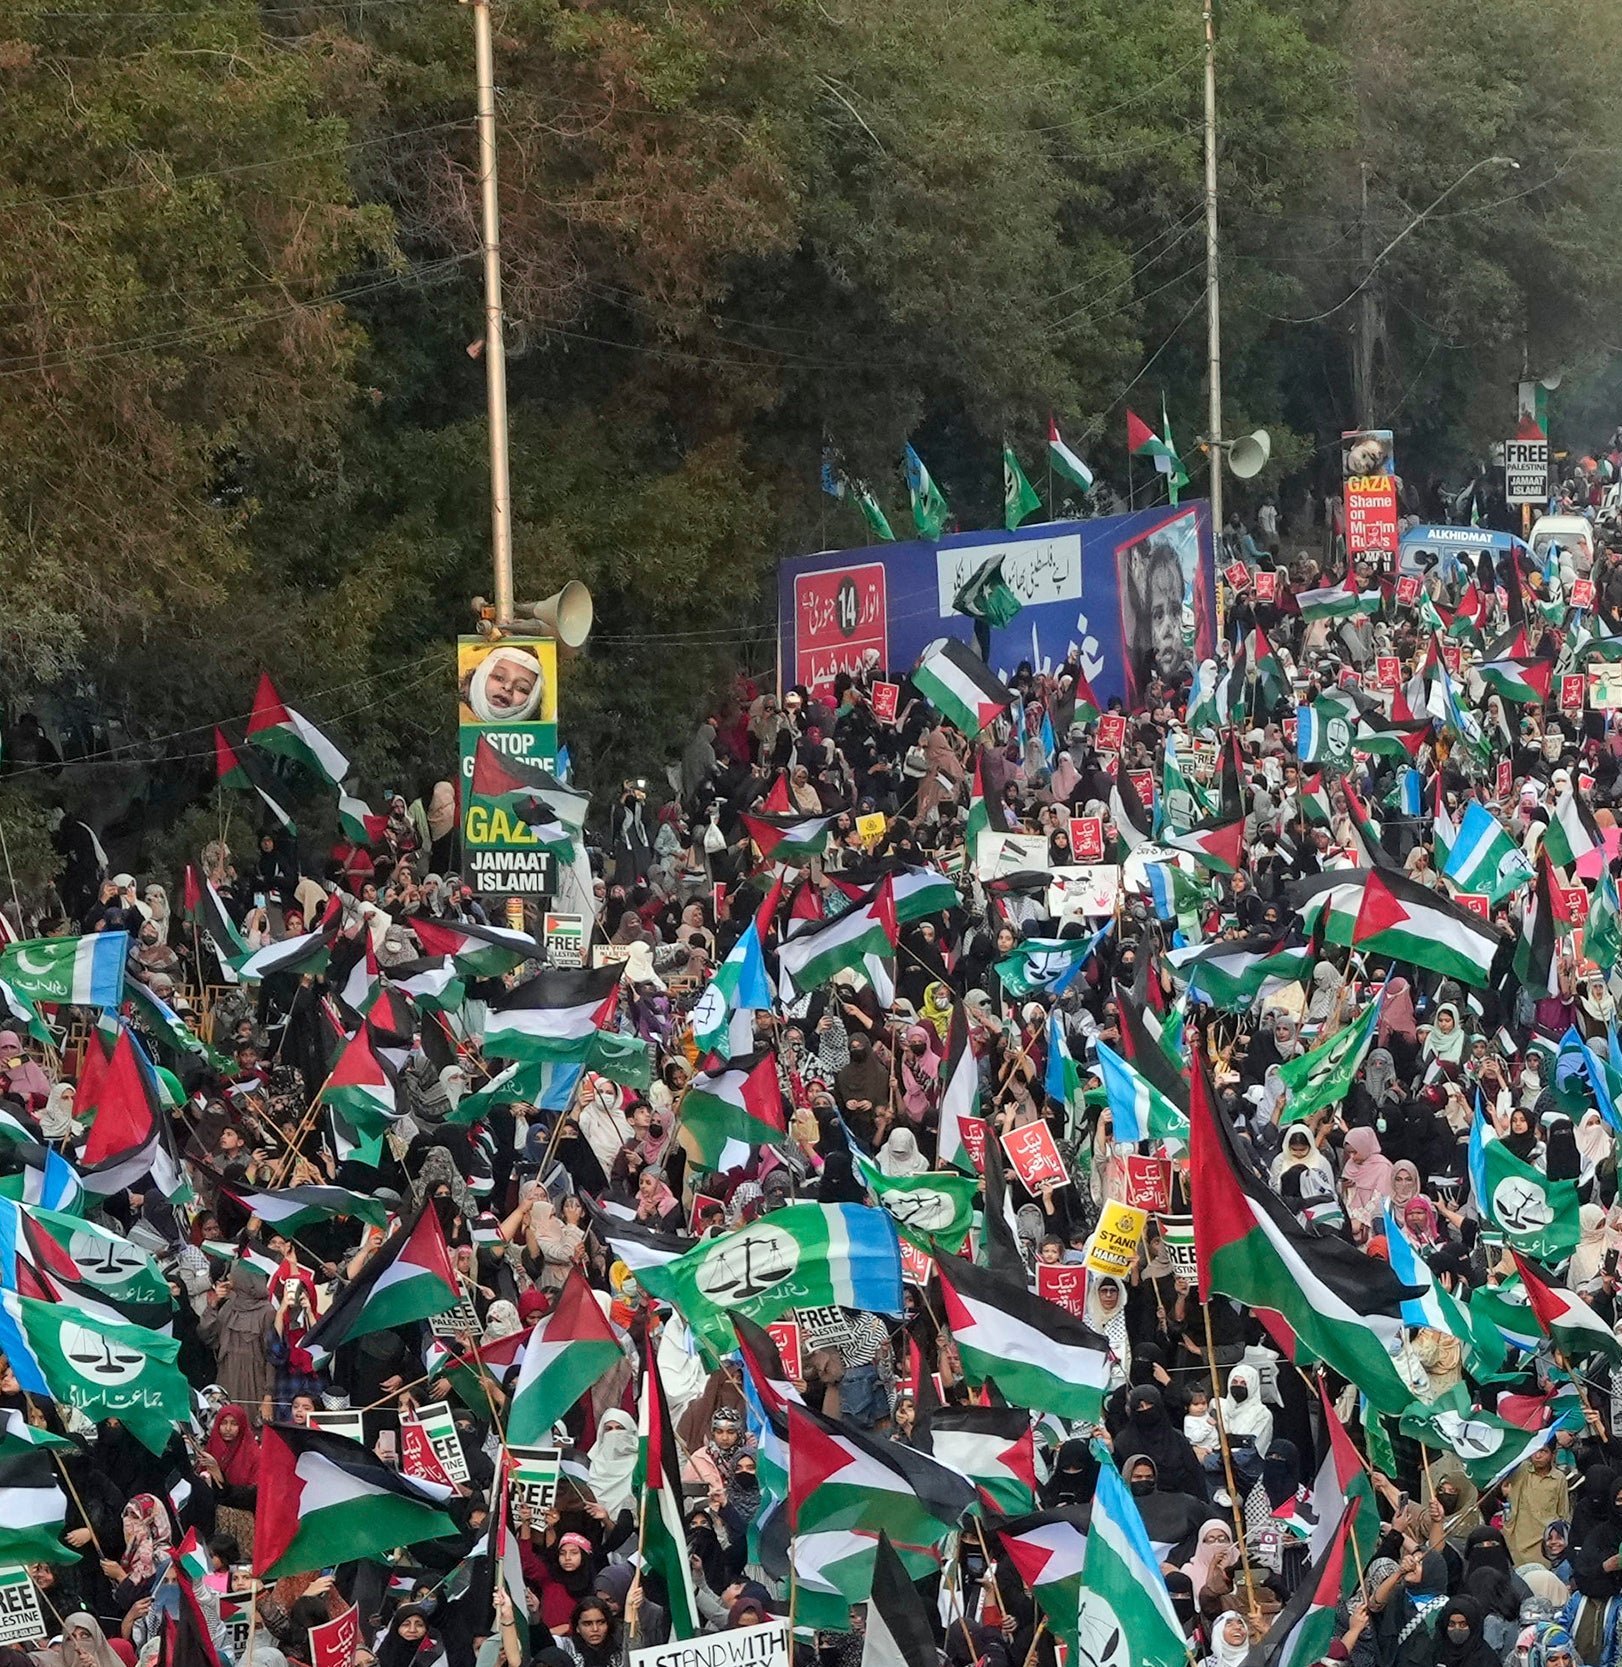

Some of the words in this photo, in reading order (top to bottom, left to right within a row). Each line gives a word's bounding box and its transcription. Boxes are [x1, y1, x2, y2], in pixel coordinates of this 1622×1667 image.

[1507, 445, 1548, 462] FREE
[1507, 463, 1548, 472] PALESTINE
[1349, 476, 1393, 493] GAZA
[1511, 477, 1544, 486] JAMAAT
[1513, 486, 1542, 496] ISLAMI
[1349, 496, 1393, 508] Shame
[1349, 510, 1367, 521] on
[1428, 530, 1493, 544] ALKHIDMAT
[839, 586, 857, 629] 14
[486, 733, 535, 755] STOP
[471, 851, 550, 872] JAMAAT
[478, 871, 544, 892] ISLAMI
[547, 937, 581, 951] FREE
[1098, 1230, 1137, 1252] STAND
[1092, 1248, 1130, 1268] HAMAS
[801, 1305, 842, 1330] FREE
[434, 1436, 460, 1461] EE
[728, 1629, 787, 1665] WITH
